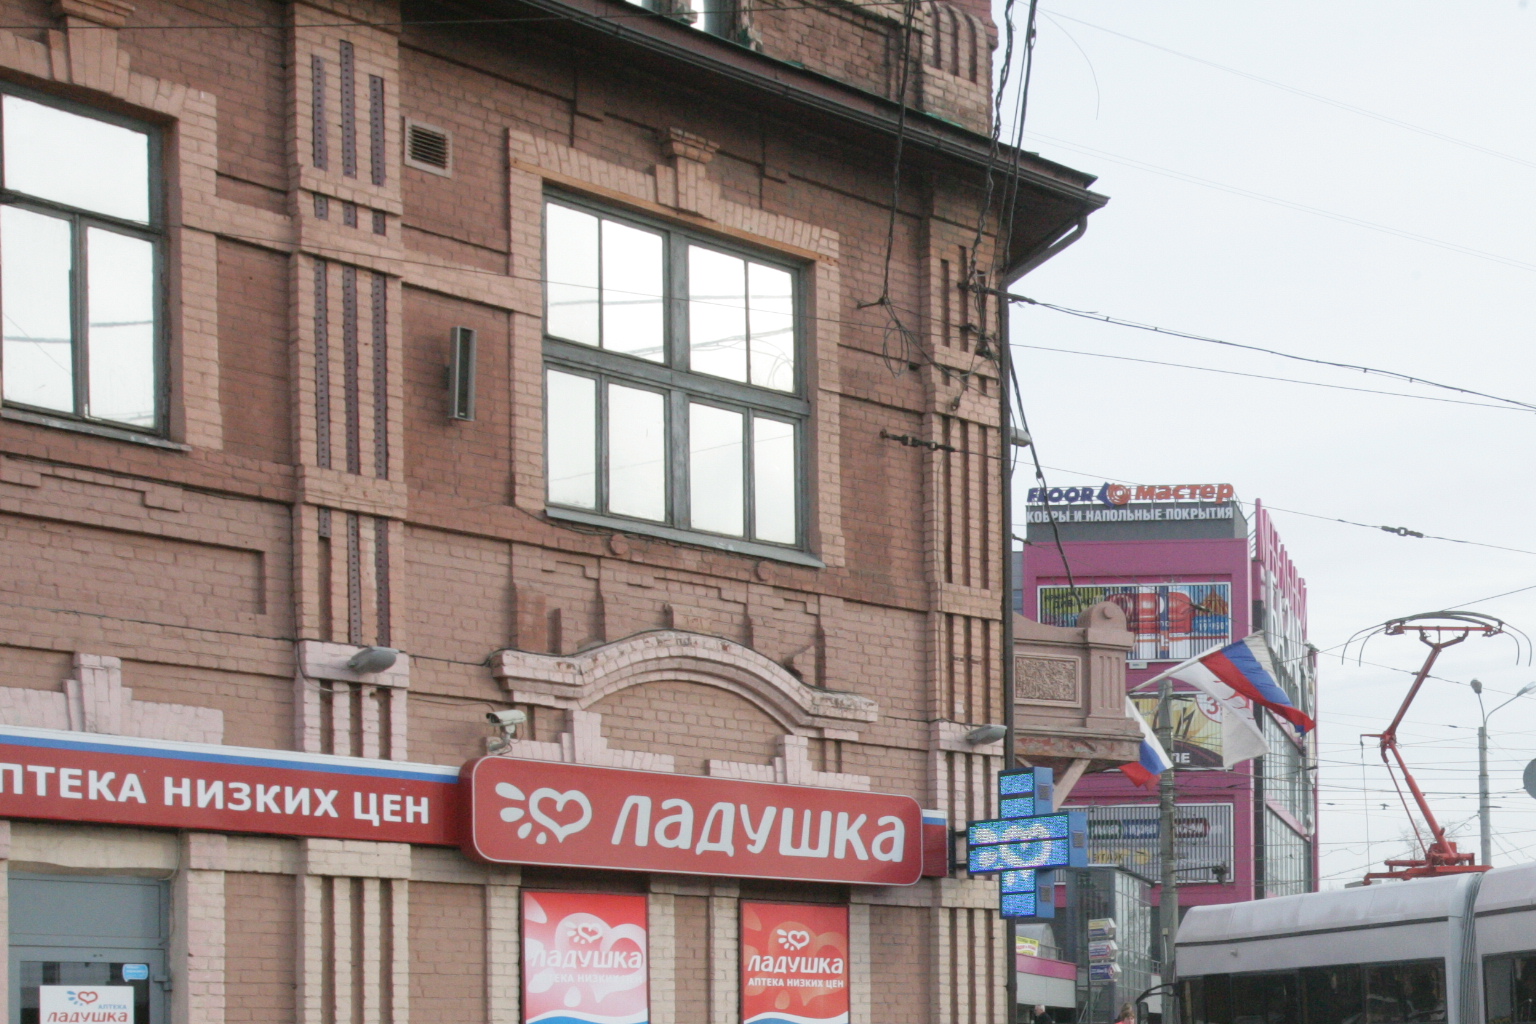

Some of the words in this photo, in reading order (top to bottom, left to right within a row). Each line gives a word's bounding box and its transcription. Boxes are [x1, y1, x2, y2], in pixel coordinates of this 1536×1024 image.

[1027, 487, 1094, 503] FLOOR
[1026, 511, 1070, 523] КОВРЫ
[1074, 510, 1082, 522] И
[1086, 508, 1162, 522] НАПОЛЬНЫЕ
[1166, 507, 1233, 520] ПОКРЫТИЯ
[0, 762, 147, 804] ПТЕКА
[163, 776, 340, 819] НИЗКИХ
[353, 791, 430, 827] ЦЕН
[748, 977, 785, 987] АПТЕКА
[787, 978, 824, 988] НИЗКИХ
[826, 979, 844, 989] ЦЕН
